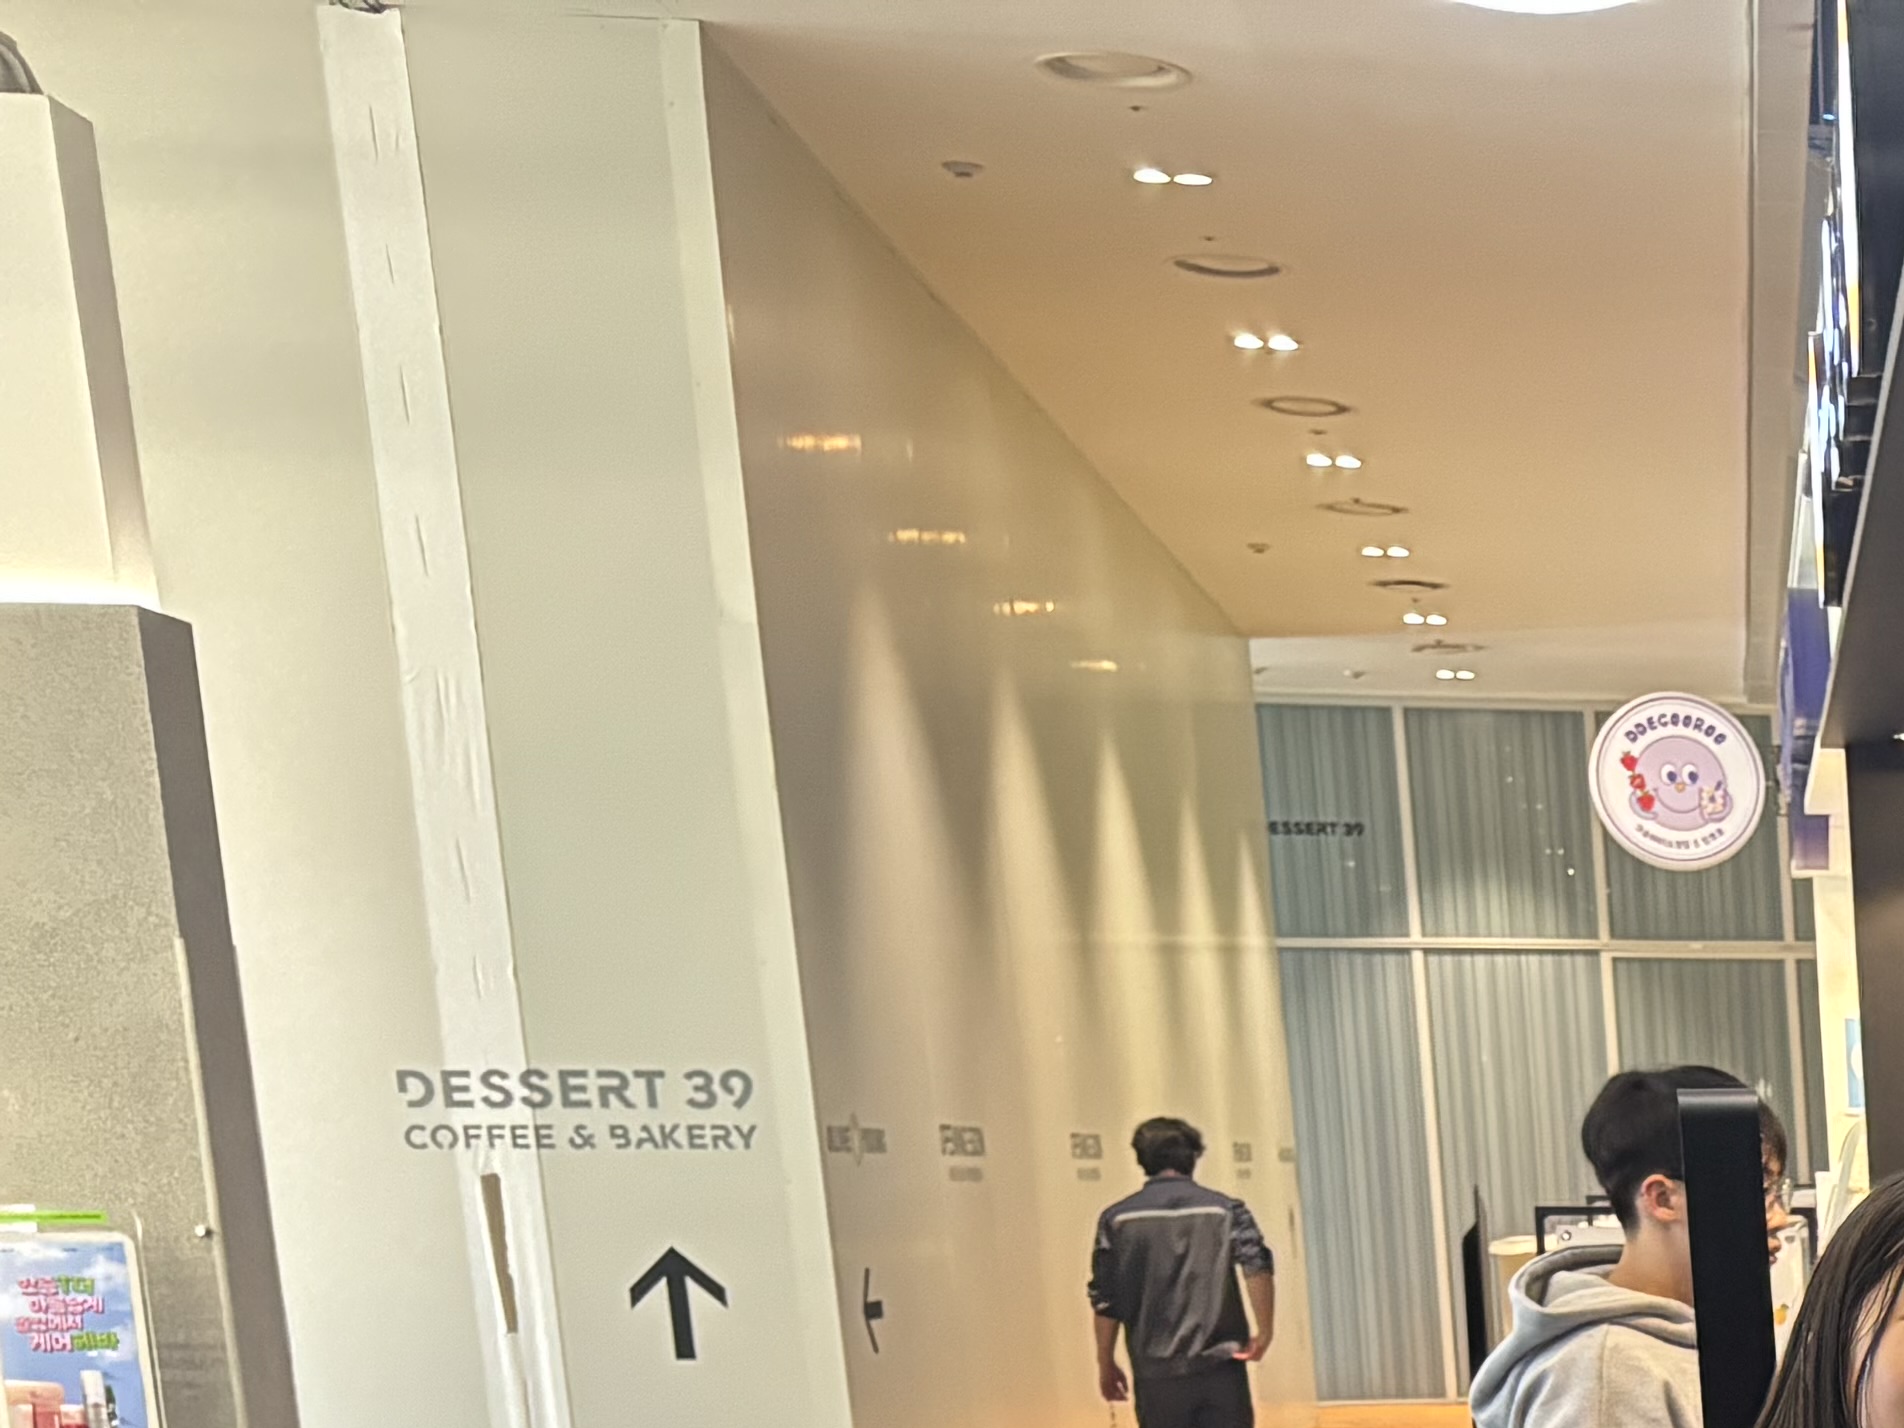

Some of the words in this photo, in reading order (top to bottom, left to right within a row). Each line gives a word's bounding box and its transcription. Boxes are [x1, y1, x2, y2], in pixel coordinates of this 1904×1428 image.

[1269, 821, 1338, 837] ESSERT
[396, 1068, 665, 1110] DESSERT
[683, 1068, 754, 1110] 39
[404, 1124, 556, 1150] COFFEE
[568, 1124, 596, 1150] &
[609, 1123, 757, 1151] BAKERY
